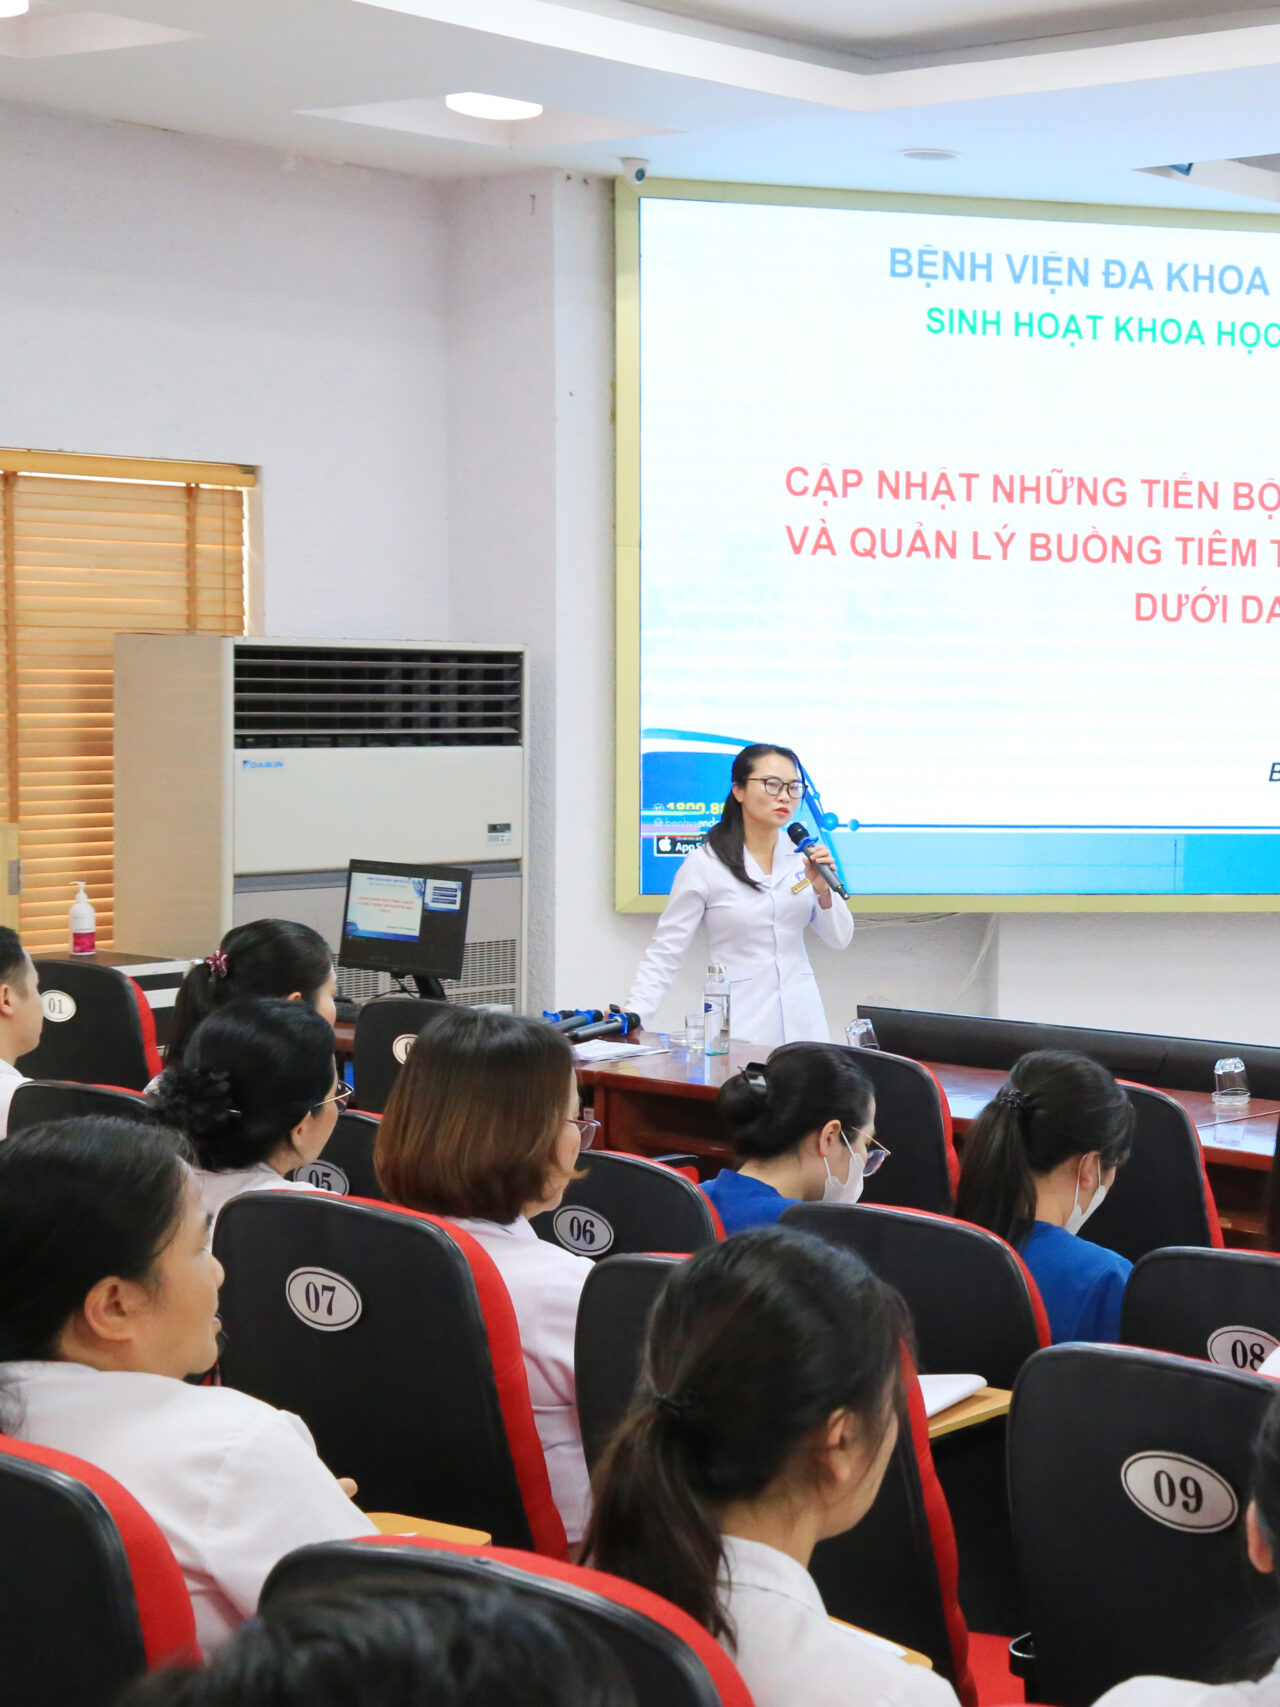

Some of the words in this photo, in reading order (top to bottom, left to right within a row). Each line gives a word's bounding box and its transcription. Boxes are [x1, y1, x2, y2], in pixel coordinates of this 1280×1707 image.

[890, 244, 992, 288] BỆNH
[1005, 251, 1089, 294] VIỆN
[1101, 259, 1154, 291] ĐA
[1166, 262, 1270, 296] KHOA
[926, 307, 1001, 336] SINH
[1014, 311, 1104, 347] HOẠT
[1115, 316, 1206, 346] KHOA
[786, 464, 863, 506] CẬP
[878, 467, 979, 510] NHẬT
[993, 469, 1127, 507] NHỮNG
[1141, 472, 1218, 509] TIẾN
[785, 518, 836, 556] VÀ
[850, 522, 956, 559] QUẢN
[973, 524, 1016, 560] LÝ
[1030, 526, 1161, 565] BUỒNG
[1175, 529, 1256, 567] TIÊM
[1136, 586, 1227, 623] DƯỚI
[49, 998, 64, 1014] 01
[309, 1170, 332, 1191] 05
[570, 1216, 596, 1245] 06
[305, 1281, 336, 1316] 07
[1231, 1339, 1265, 1372] 08
[1154, 1470, 1203, 1514] 09
